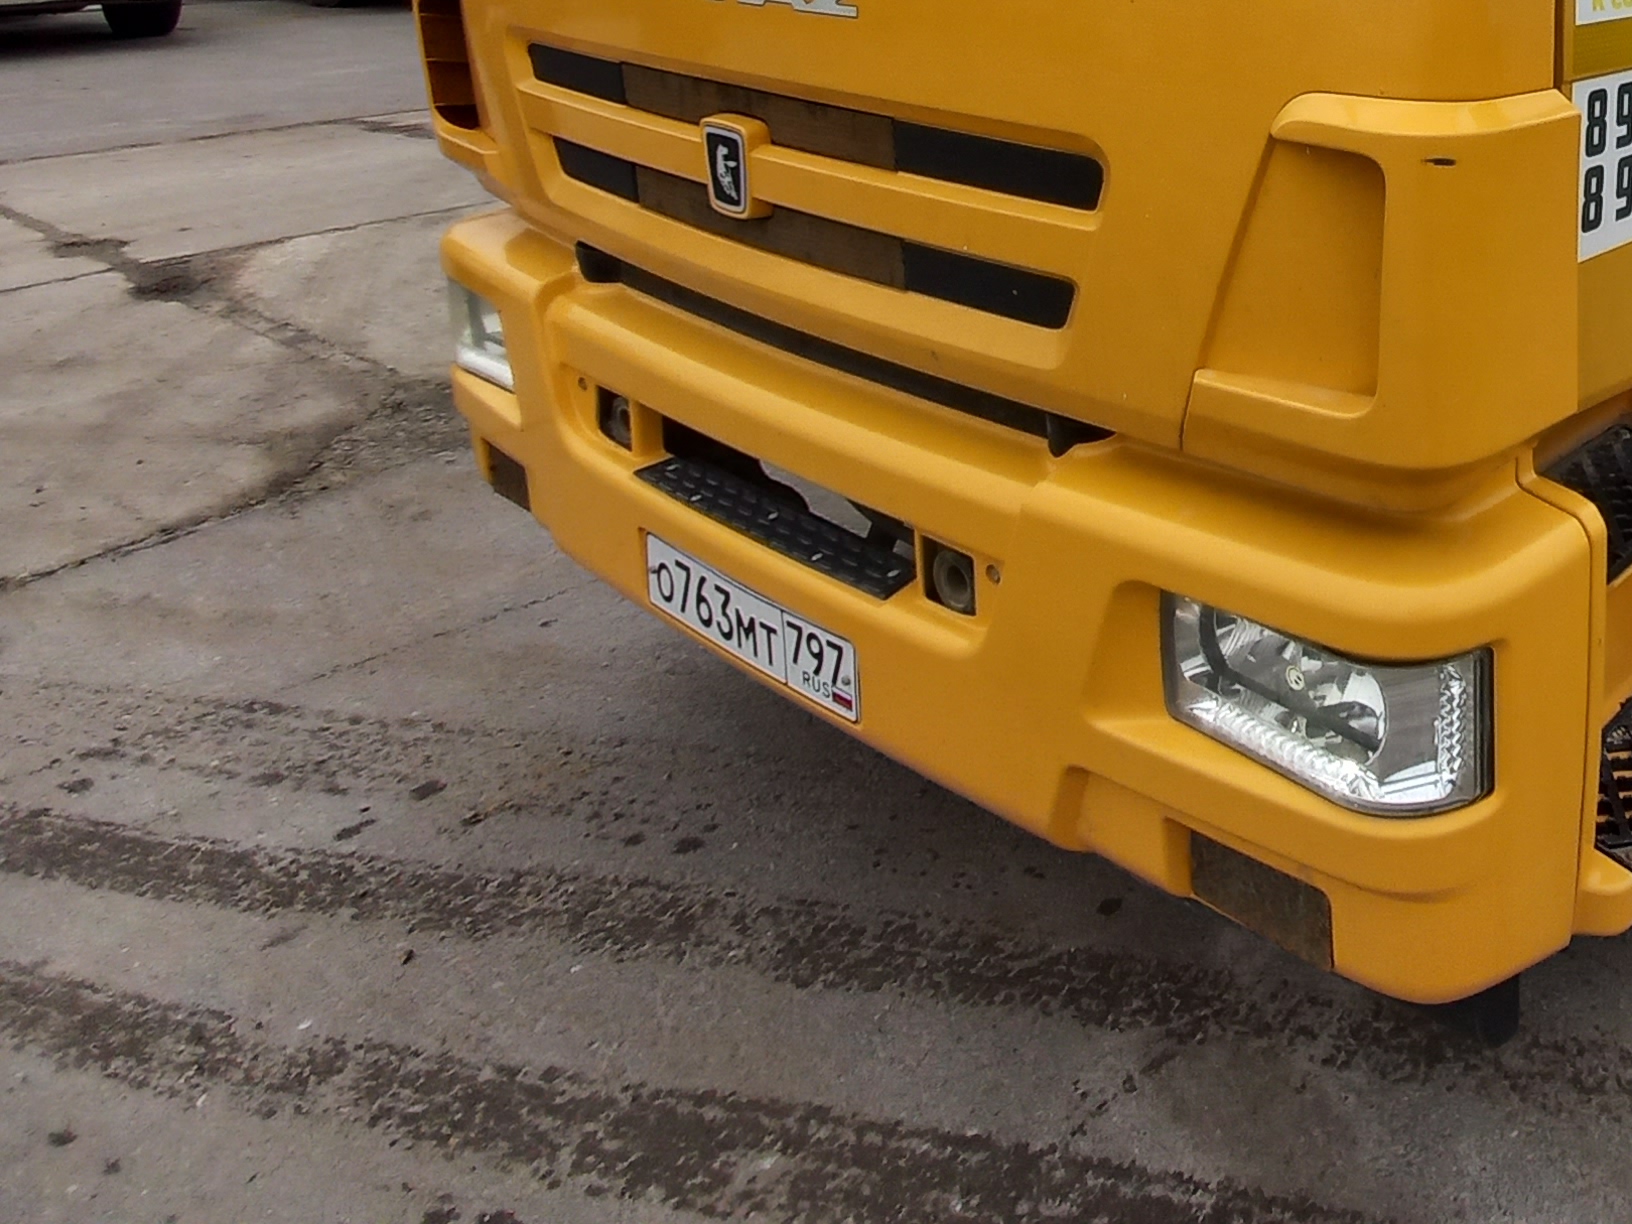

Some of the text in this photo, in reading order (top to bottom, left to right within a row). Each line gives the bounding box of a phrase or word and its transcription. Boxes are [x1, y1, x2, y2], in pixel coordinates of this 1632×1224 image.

[1585, 89, 1607, 158] 8
[1581, 163, 1604, 234] 8
[787, 620, 844, 688] 797
[802, 671, 831, 699] RUS
